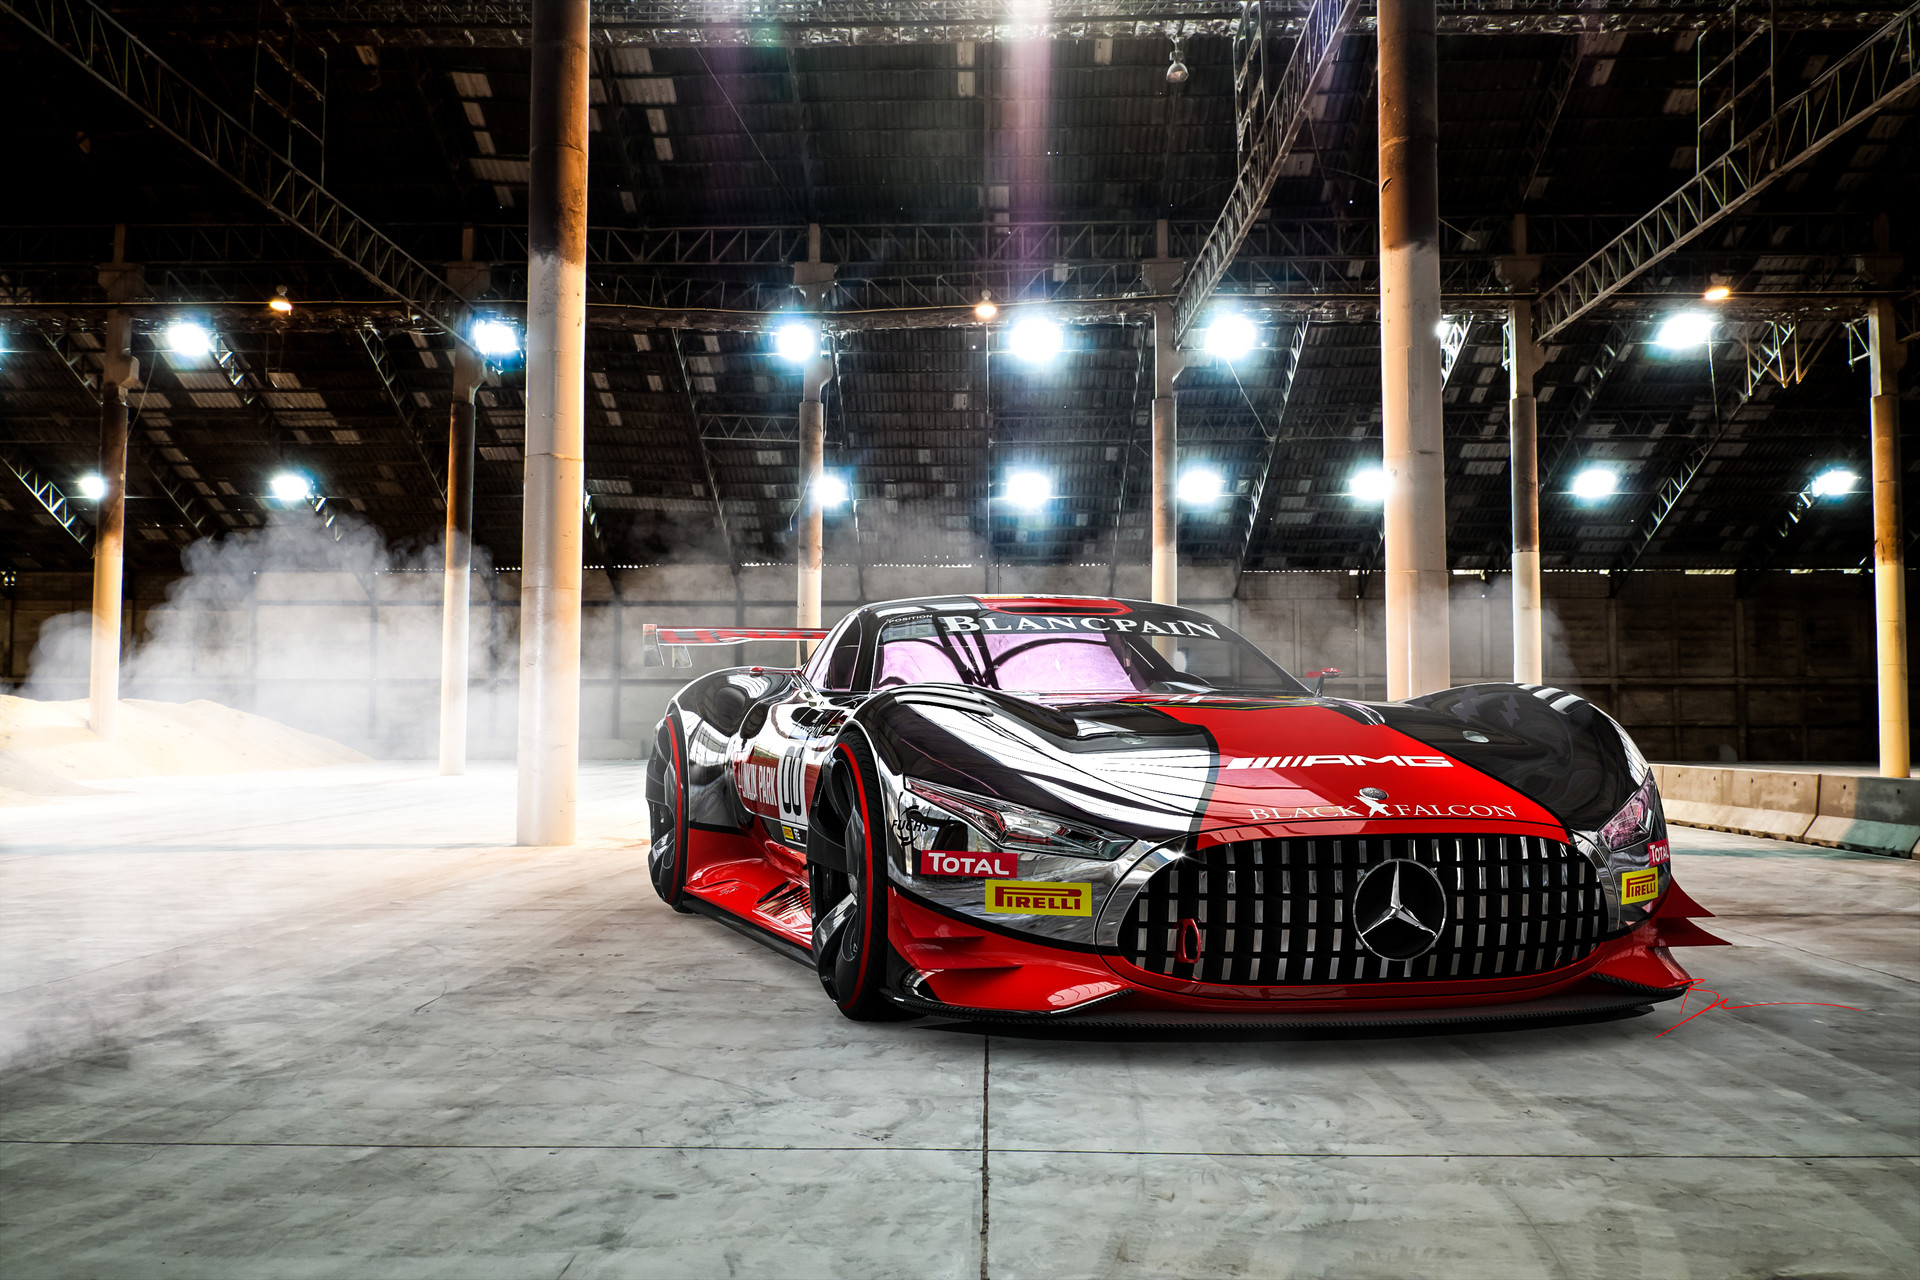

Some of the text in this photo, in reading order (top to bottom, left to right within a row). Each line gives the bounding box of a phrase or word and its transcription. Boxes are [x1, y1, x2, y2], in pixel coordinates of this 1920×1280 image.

[888, 614, 933, 624] POSITION
[937, 615, 1221, 640] BLANCPAIN
[759, 765, 778, 807] PARK
[1248, 804, 1517, 821] BLACK FALCON
[891, 819, 929, 832] FUCHS
[928, 852, 1010, 876] TOTAL
[1626, 873, 1656, 898] PIRELLI
[994, 886, 1082, 910] PIRELLI
